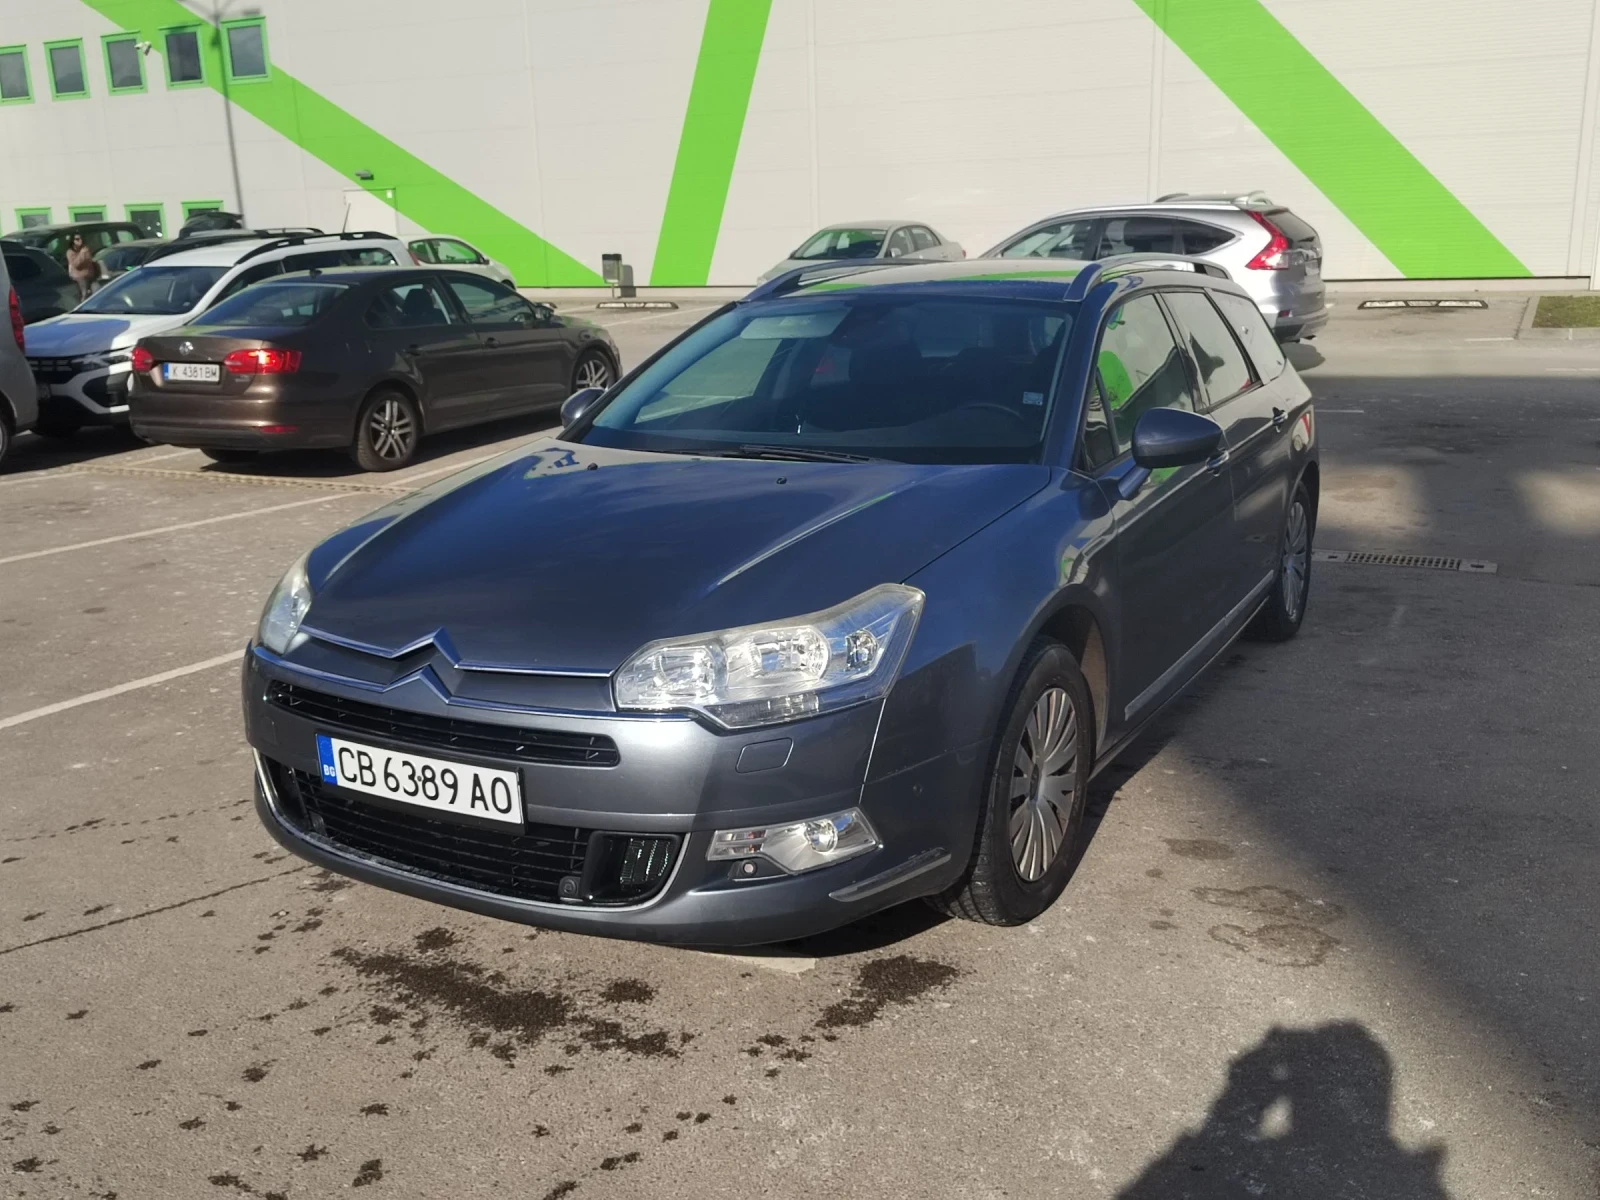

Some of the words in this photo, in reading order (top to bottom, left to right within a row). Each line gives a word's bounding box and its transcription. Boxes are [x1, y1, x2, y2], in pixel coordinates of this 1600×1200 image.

[323, 764, 336, 777] BG
[338, 746, 377, 787] CB
[383, 757, 459, 805] 6389
[470, 773, 513, 814] AO
